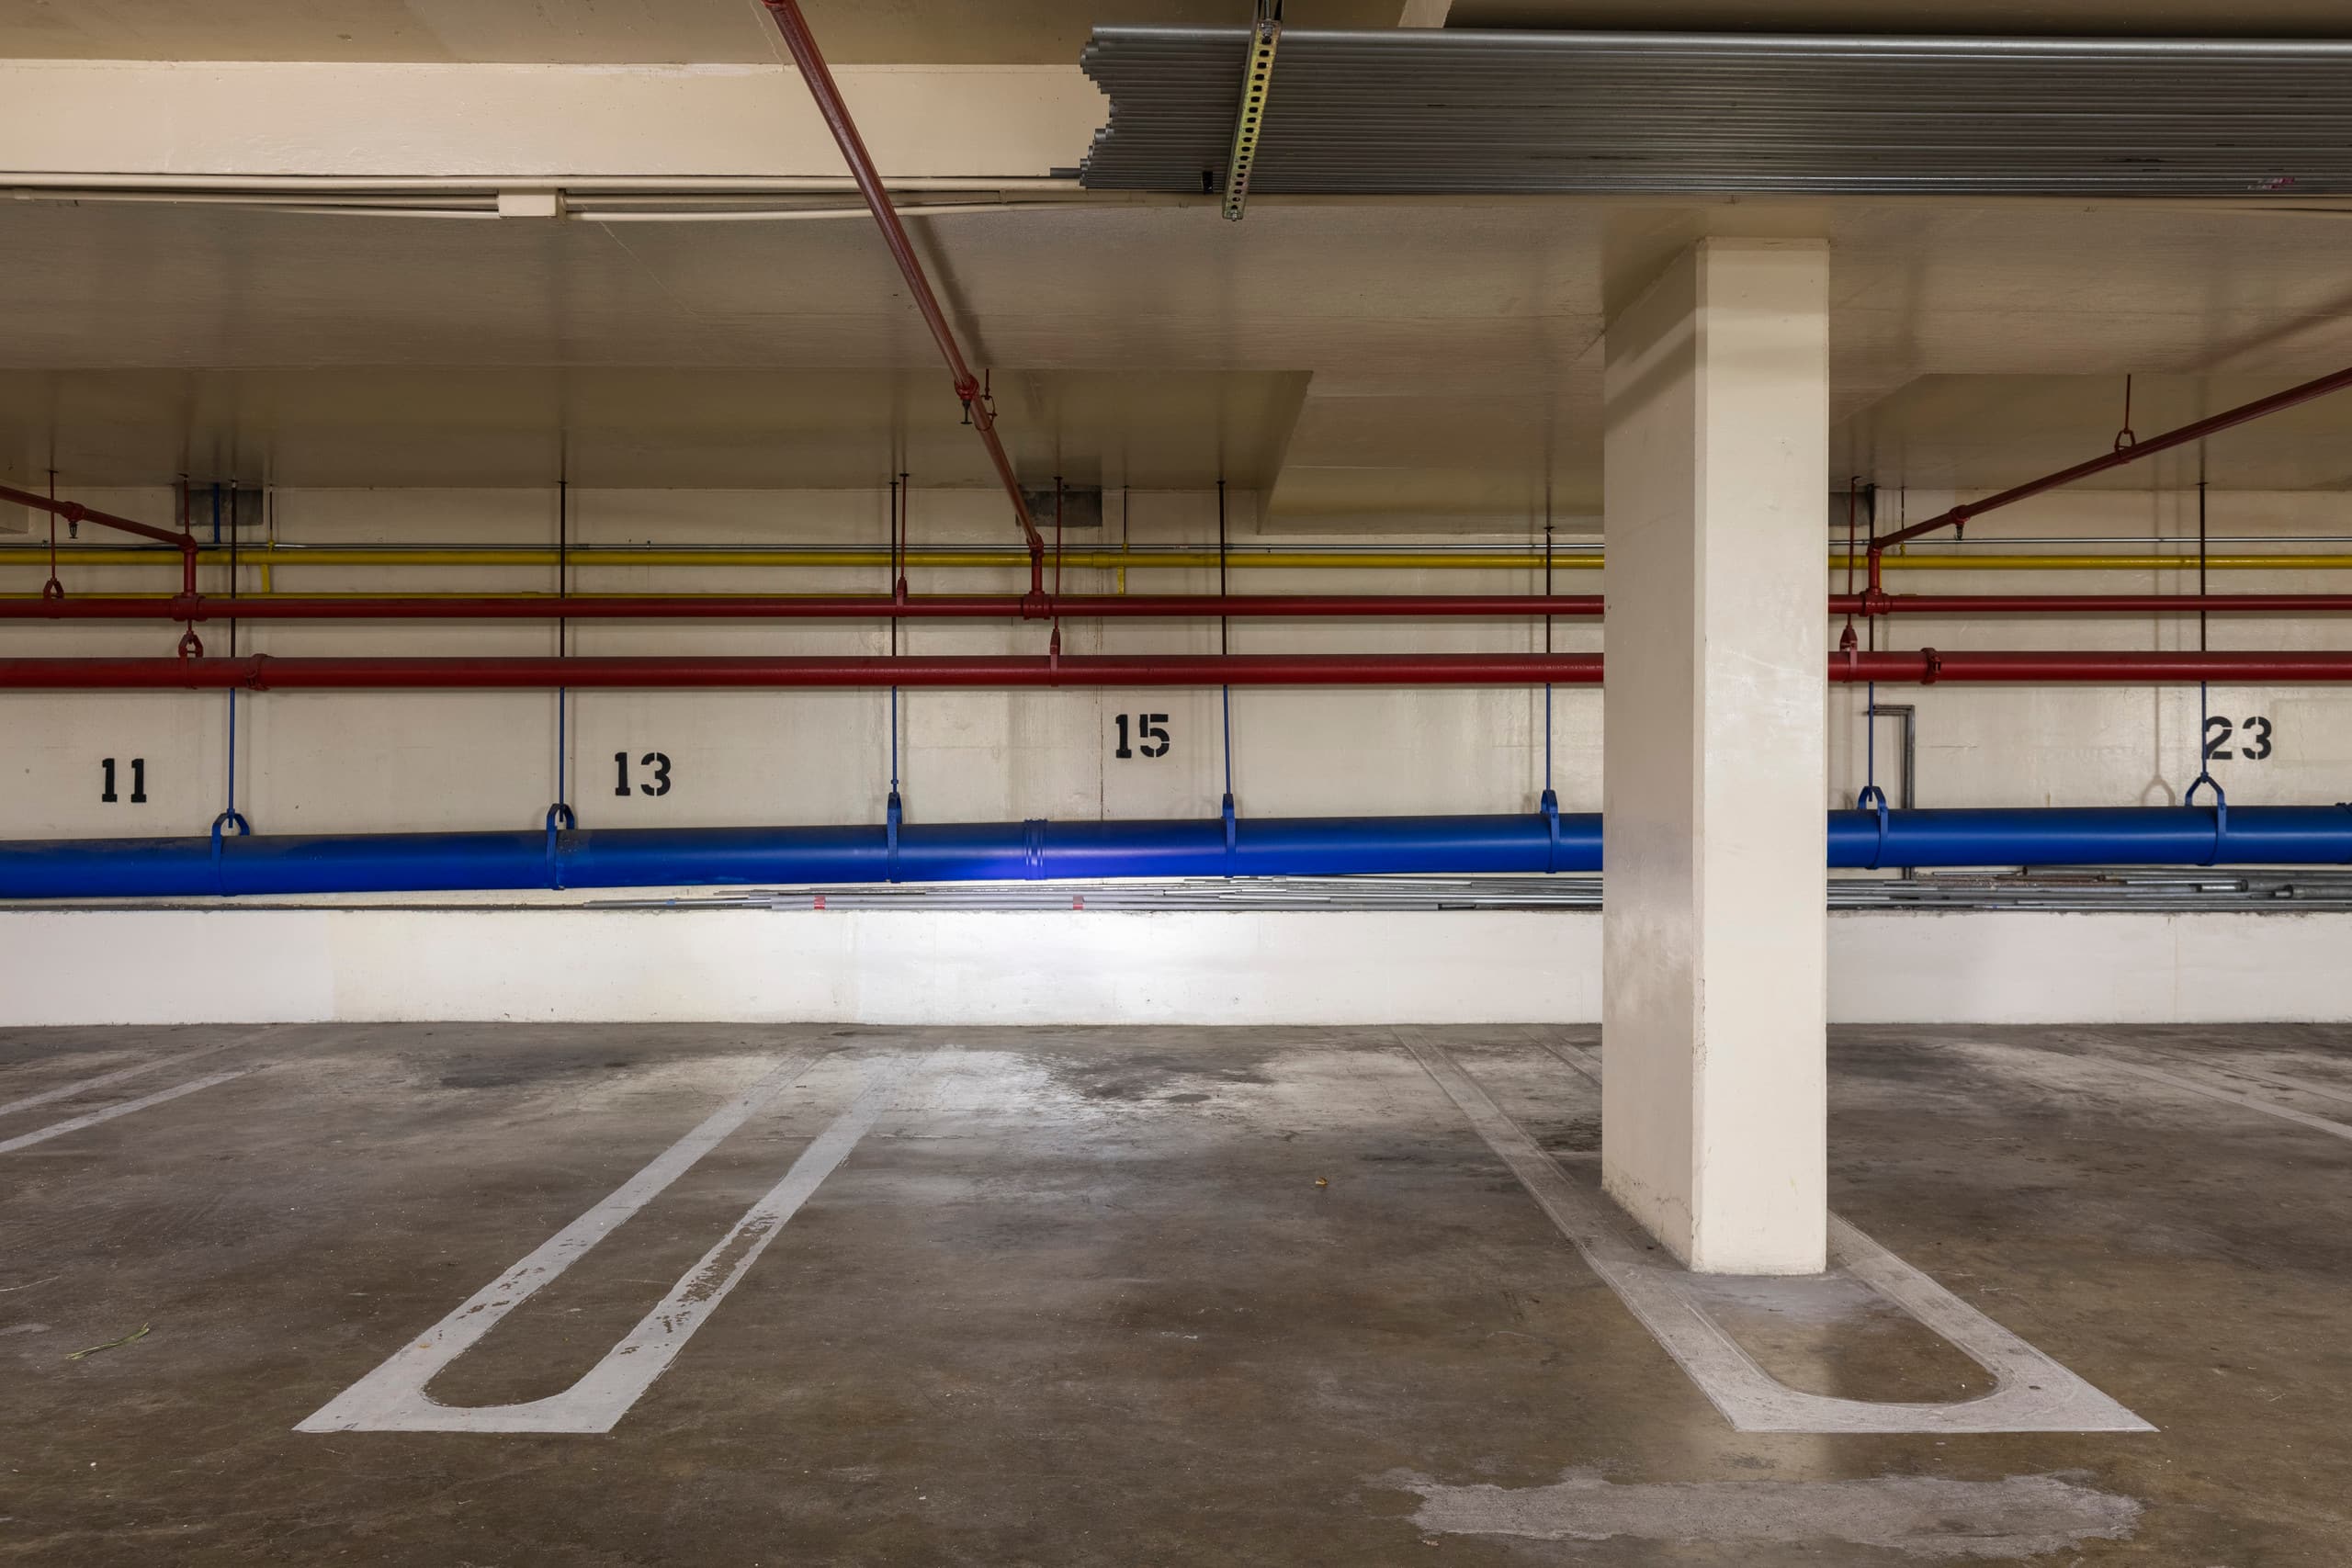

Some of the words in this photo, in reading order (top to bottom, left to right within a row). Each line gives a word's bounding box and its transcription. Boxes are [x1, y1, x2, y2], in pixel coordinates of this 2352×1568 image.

[1115, 714, 1170, 759] 15
[2205, 716, 2271, 760] 23
[102, 758, 147, 803] 11
[615, 751, 671, 796] 13
